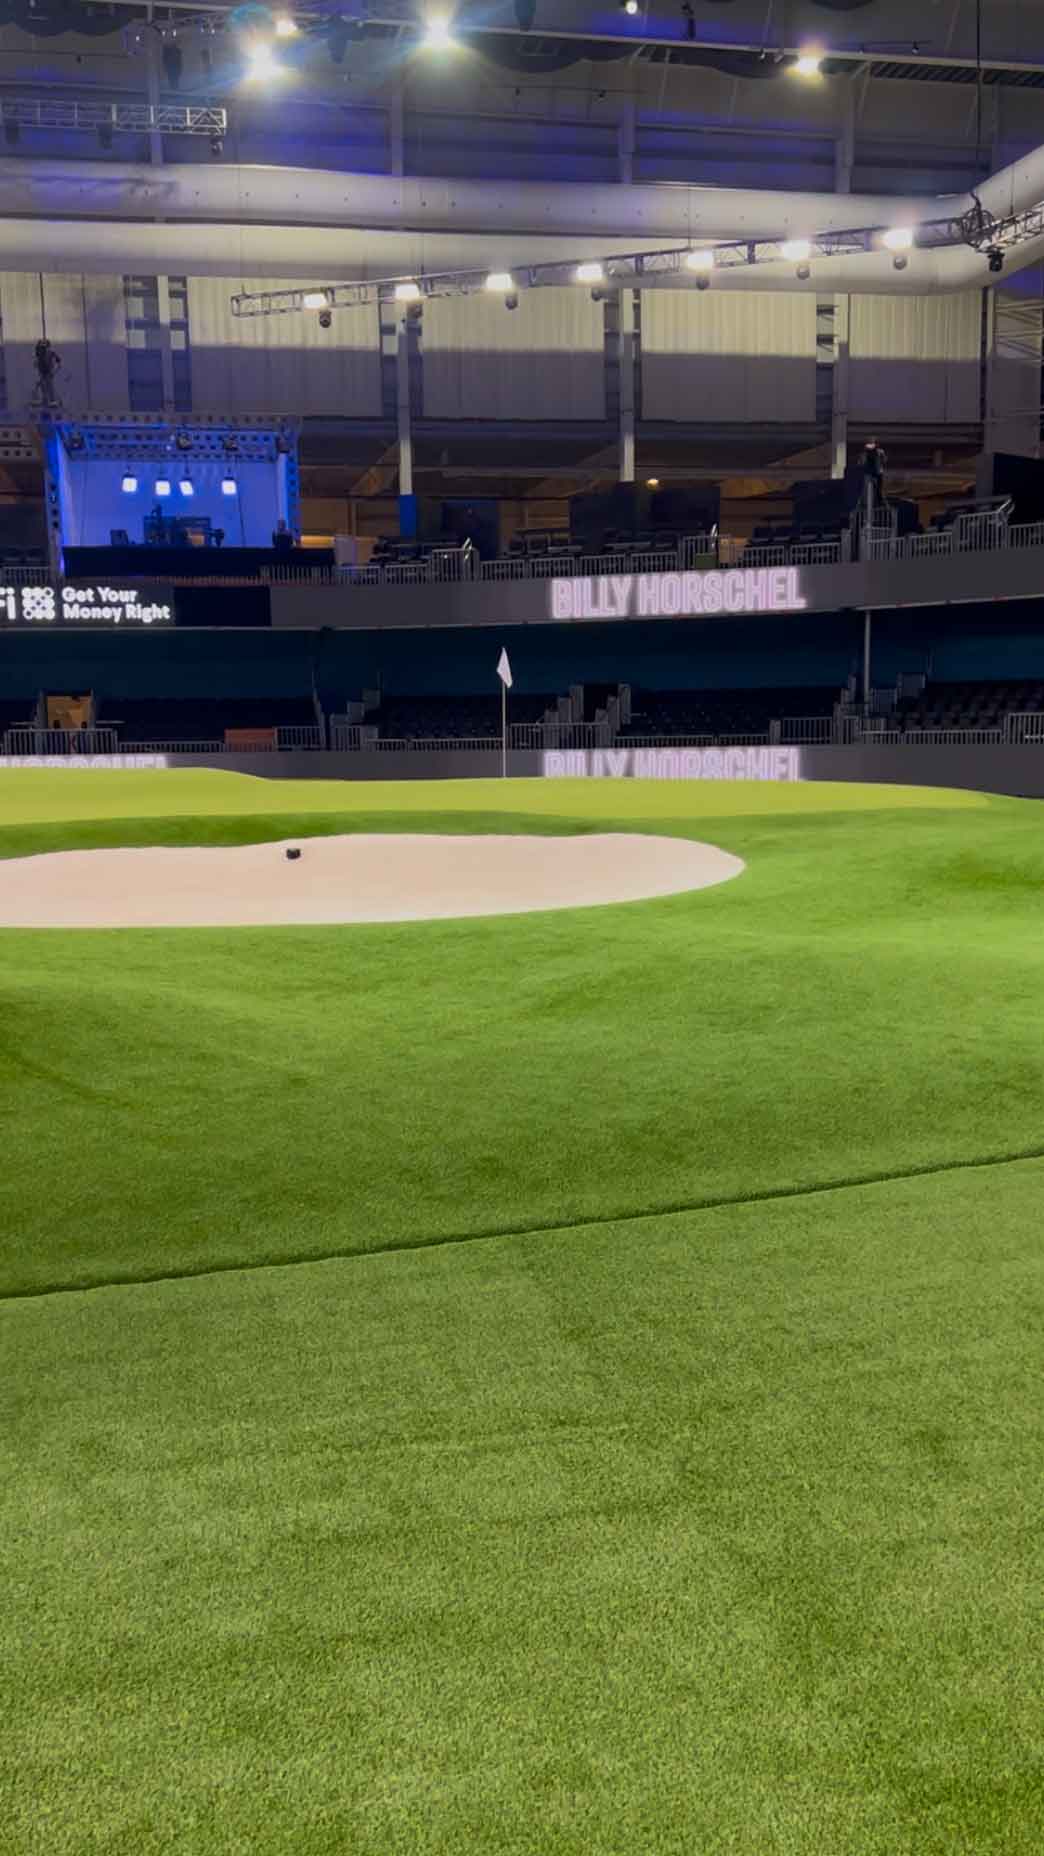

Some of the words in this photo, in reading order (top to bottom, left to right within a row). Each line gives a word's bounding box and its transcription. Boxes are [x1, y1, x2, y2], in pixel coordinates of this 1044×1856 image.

[62, 587, 94, 602] Get
[96, 587, 138, 602] Your
[551, 575, 632, 619] BILLY
[637, 566, 808, 616] HORSCHEL
[62, 603, 122, 623] Money
[125, 603, 170, 623] Right
